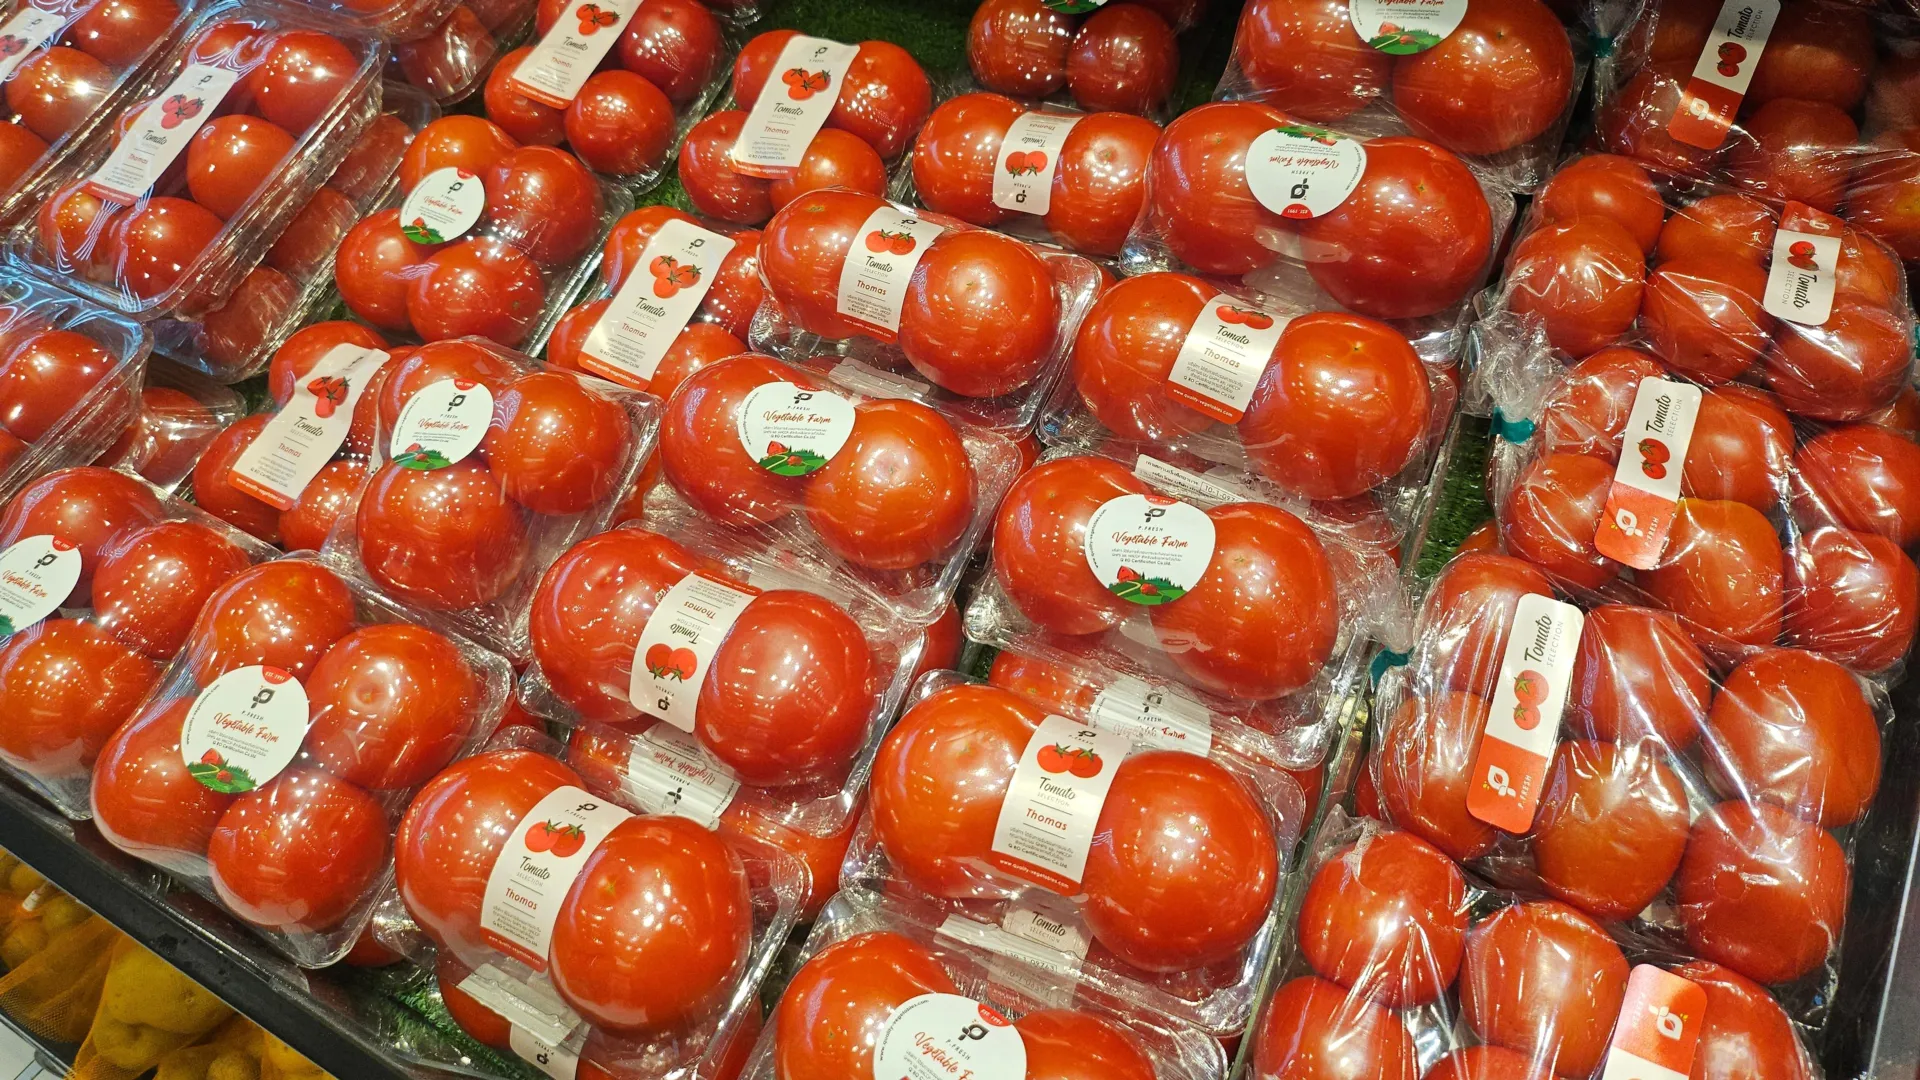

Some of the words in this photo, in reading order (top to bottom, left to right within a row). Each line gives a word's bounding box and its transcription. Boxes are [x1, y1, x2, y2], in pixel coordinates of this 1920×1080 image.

[1727, 6, 1754, 38] Tomato
[1747, 10, 1764, 40] SELECTION
[563, 36, 588, 51] Tomato
[773, 102, 804, 116] Tomato
[764, 126, 790, 135] Thomas
[1029, 123, 1056, 132] Thomas
[142, 130, 167, 146] Tomato
[1022, 136, 1046, 148] Tomato
[1269, 156, 1294, 167] Farm
[1296, 156, 1339, 170] Vegetable
[864, 267, 888, 278] SELECTION
[865, 255, 893, 273] Tomato
[857, 280, 887, 296] Thomas
[1782, 270, 1795, 305] SELECTION
[1793, 273, 1817, 310] Tomato
[634, 296, 666, 318] Tomato
[622, 322, 648, 338] Thomas
[1216, 324, 1250, 345] Tomato
[1215, 336, 1244, 350] SELECTION
[1204, 347, 1241, 368] Thomas
[763, 410, 805, 423] Vegetable
[806, 413, 831, 424] Farm
[1645, 394, 1671, 433] Tomato
[1666, 398, 1683, 438] SELECTION
[294, 416, 324, 438] Tomato
[418, 418, 450, 430] Vegetable
[450, 421, 470, 430] Farm
[278, 442, 302, 458] Thomas
[1112, 531, 1158, 546] Vegetable
[1161, 536, 1188, 550] Farm
[2, 570, 31, 591] Vegetable
[29, 584, 48, 598] Farm
[683, 601, 716, 620] Thomas
[670, 623, 700, 645] Tomato
[676, 618, 703, 631] SELECTION
[1524, 612, 1553, 663] Tomato
[1546, 620, 1564, 668] SELECTION
[241, 710, 264, 721] P.FRESH
[213, 712, 255, 734] Vegetable
[254, 726, 280, 743] Farm
[1161, 726, 1187, 740] Farm
[1068, 734, 1094, 745] P.FRESH
[654, 751, 677, 769] Farm
[677, 760, 716, 785] Vegetable
[1039, 776, 1076, 800] Tomato
[1518, 774, 1533, 808] P.FRESH
[1036, 791, 1070, 807] SELECTION
[1026, 807, 1068, 831] Thomas
[518, 855, 551, 880] Tomato
[516, 871, 544, 887] SELECTION
[505, 887, 538, 910] Thomas
[1032, 911, 1066, 937] Tomato
[1029, 926, 1061, 943] SELECTION
[914, 1031, 958, 1073] Vegetable
[946, 1039, 971, 1060] P.FRESH
